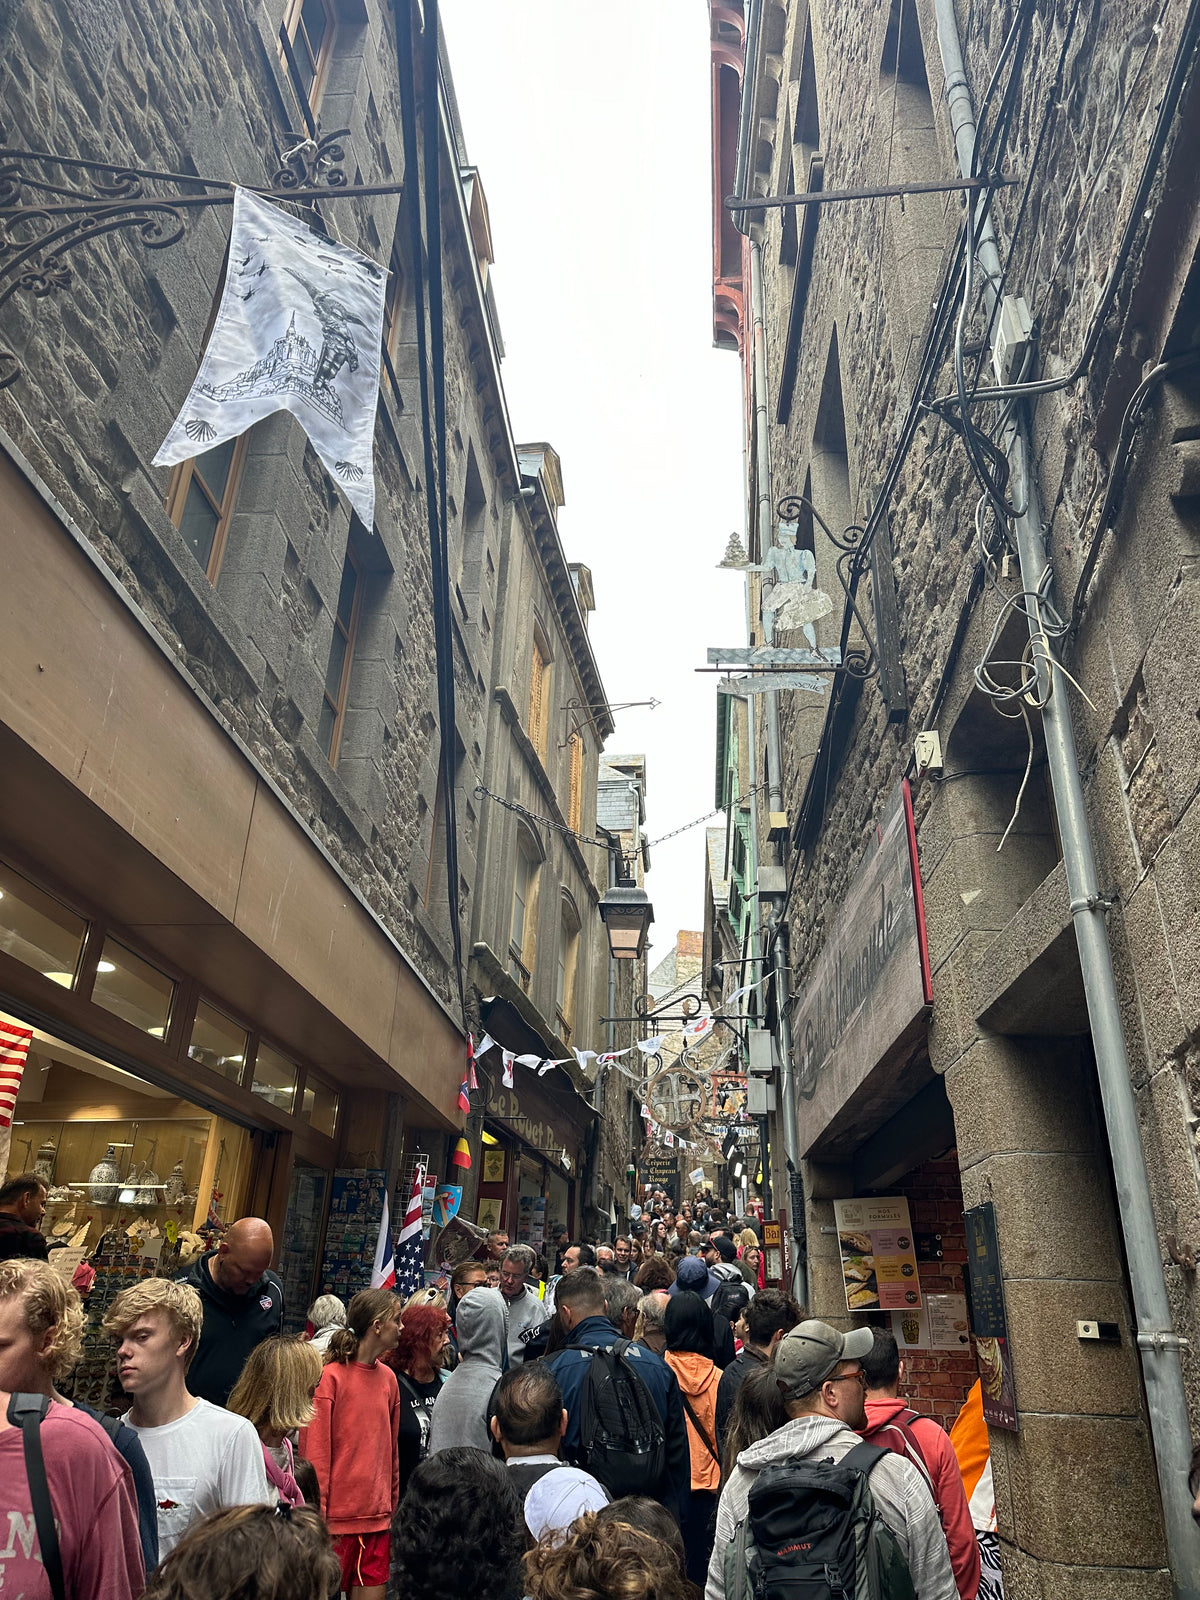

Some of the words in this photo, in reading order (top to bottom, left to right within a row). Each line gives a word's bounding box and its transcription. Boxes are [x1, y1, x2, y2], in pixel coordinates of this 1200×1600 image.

[509, 1091, 544, 1146] Rouet
[649, 1167, 676, 1176] Chapeau
[648, 1175, 669, 1185] Rouge
[777, 1542, 812, 1556] MAMMUT
